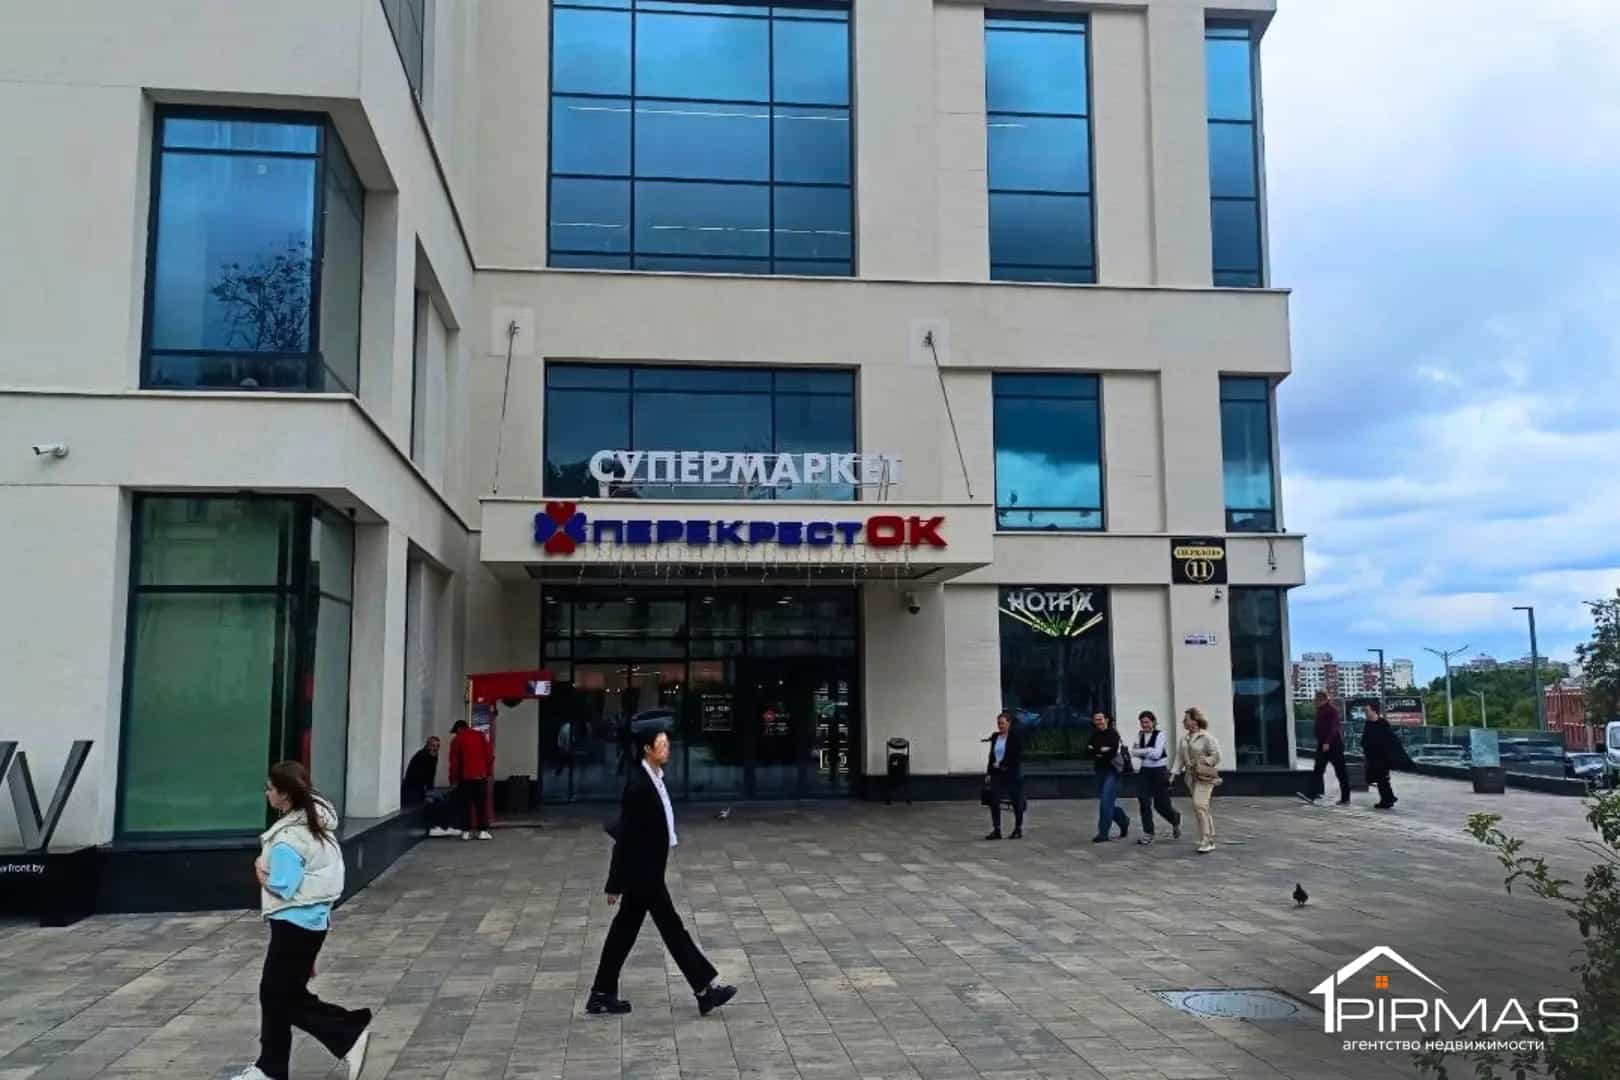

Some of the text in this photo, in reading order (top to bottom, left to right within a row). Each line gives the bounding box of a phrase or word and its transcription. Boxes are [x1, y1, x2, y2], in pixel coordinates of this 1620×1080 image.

[589, 450, 904, 483] СУПЕРМАРКЕТ
[592, 515, 948, 549] ПЕРЕКРЕСТОК
[1190, 560, 1208, 577] 11
[1007, 591, 1095, 612] HOTFIX
